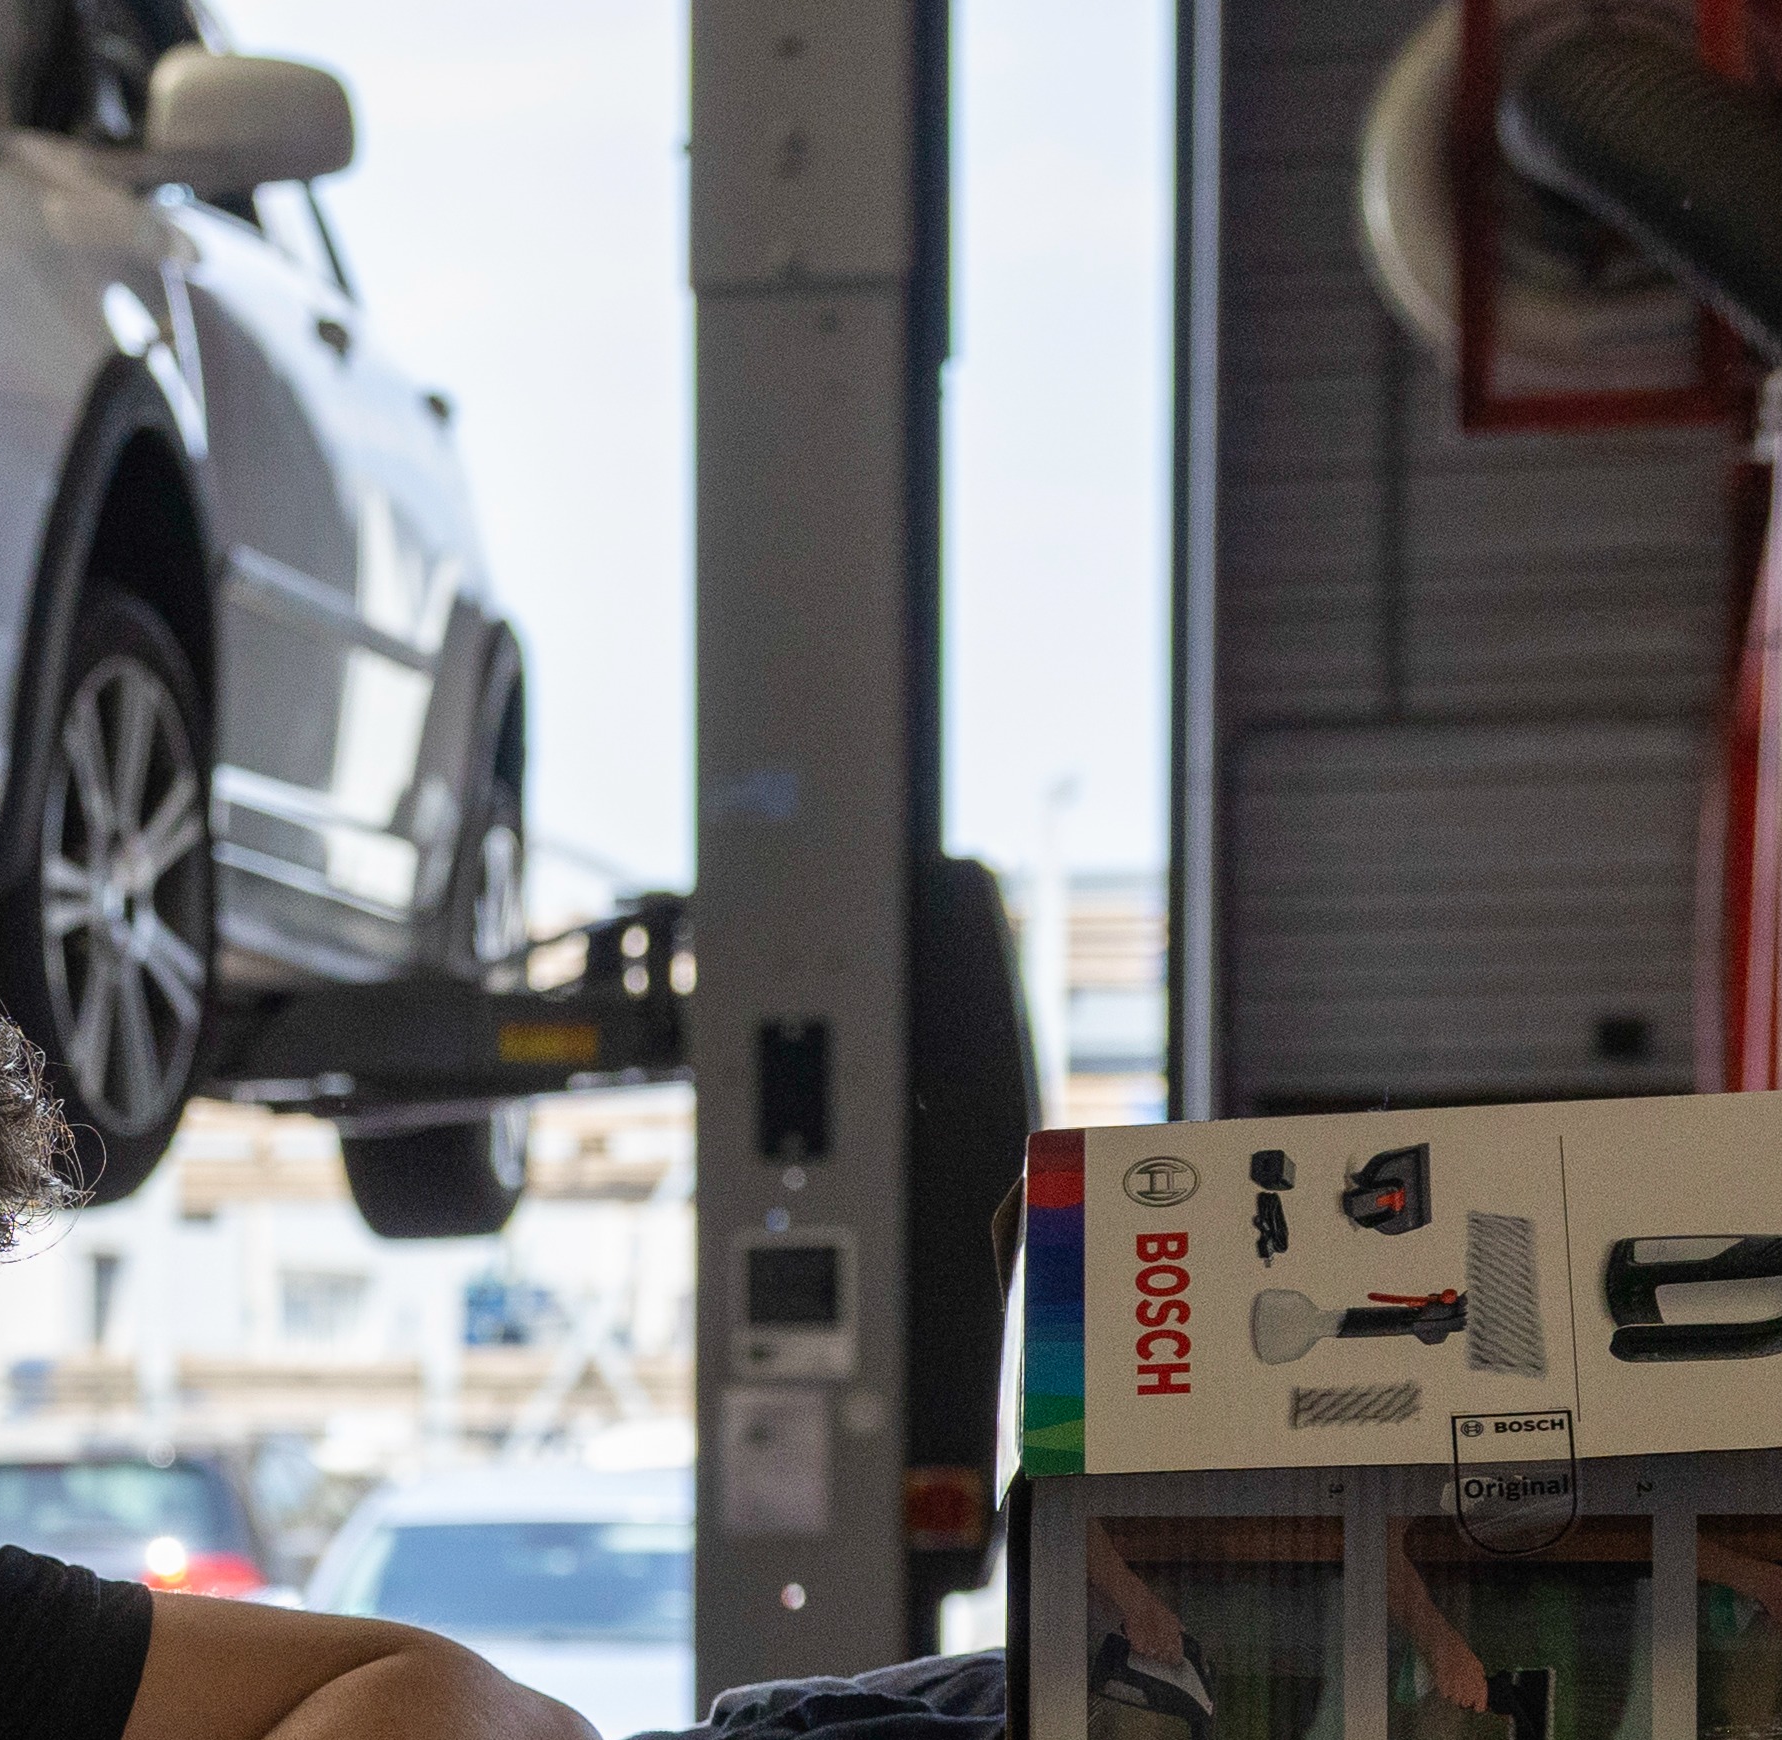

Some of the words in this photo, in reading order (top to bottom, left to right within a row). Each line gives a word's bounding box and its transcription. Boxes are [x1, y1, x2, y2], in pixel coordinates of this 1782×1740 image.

[1135, 1232, 1192, 1396] BOSCH
[1494, 1416, 1566, 1434] BOSCH
[1464, 1473, 1570, 1506] Original
[1636, 1481, 1654, 1498] 2.
